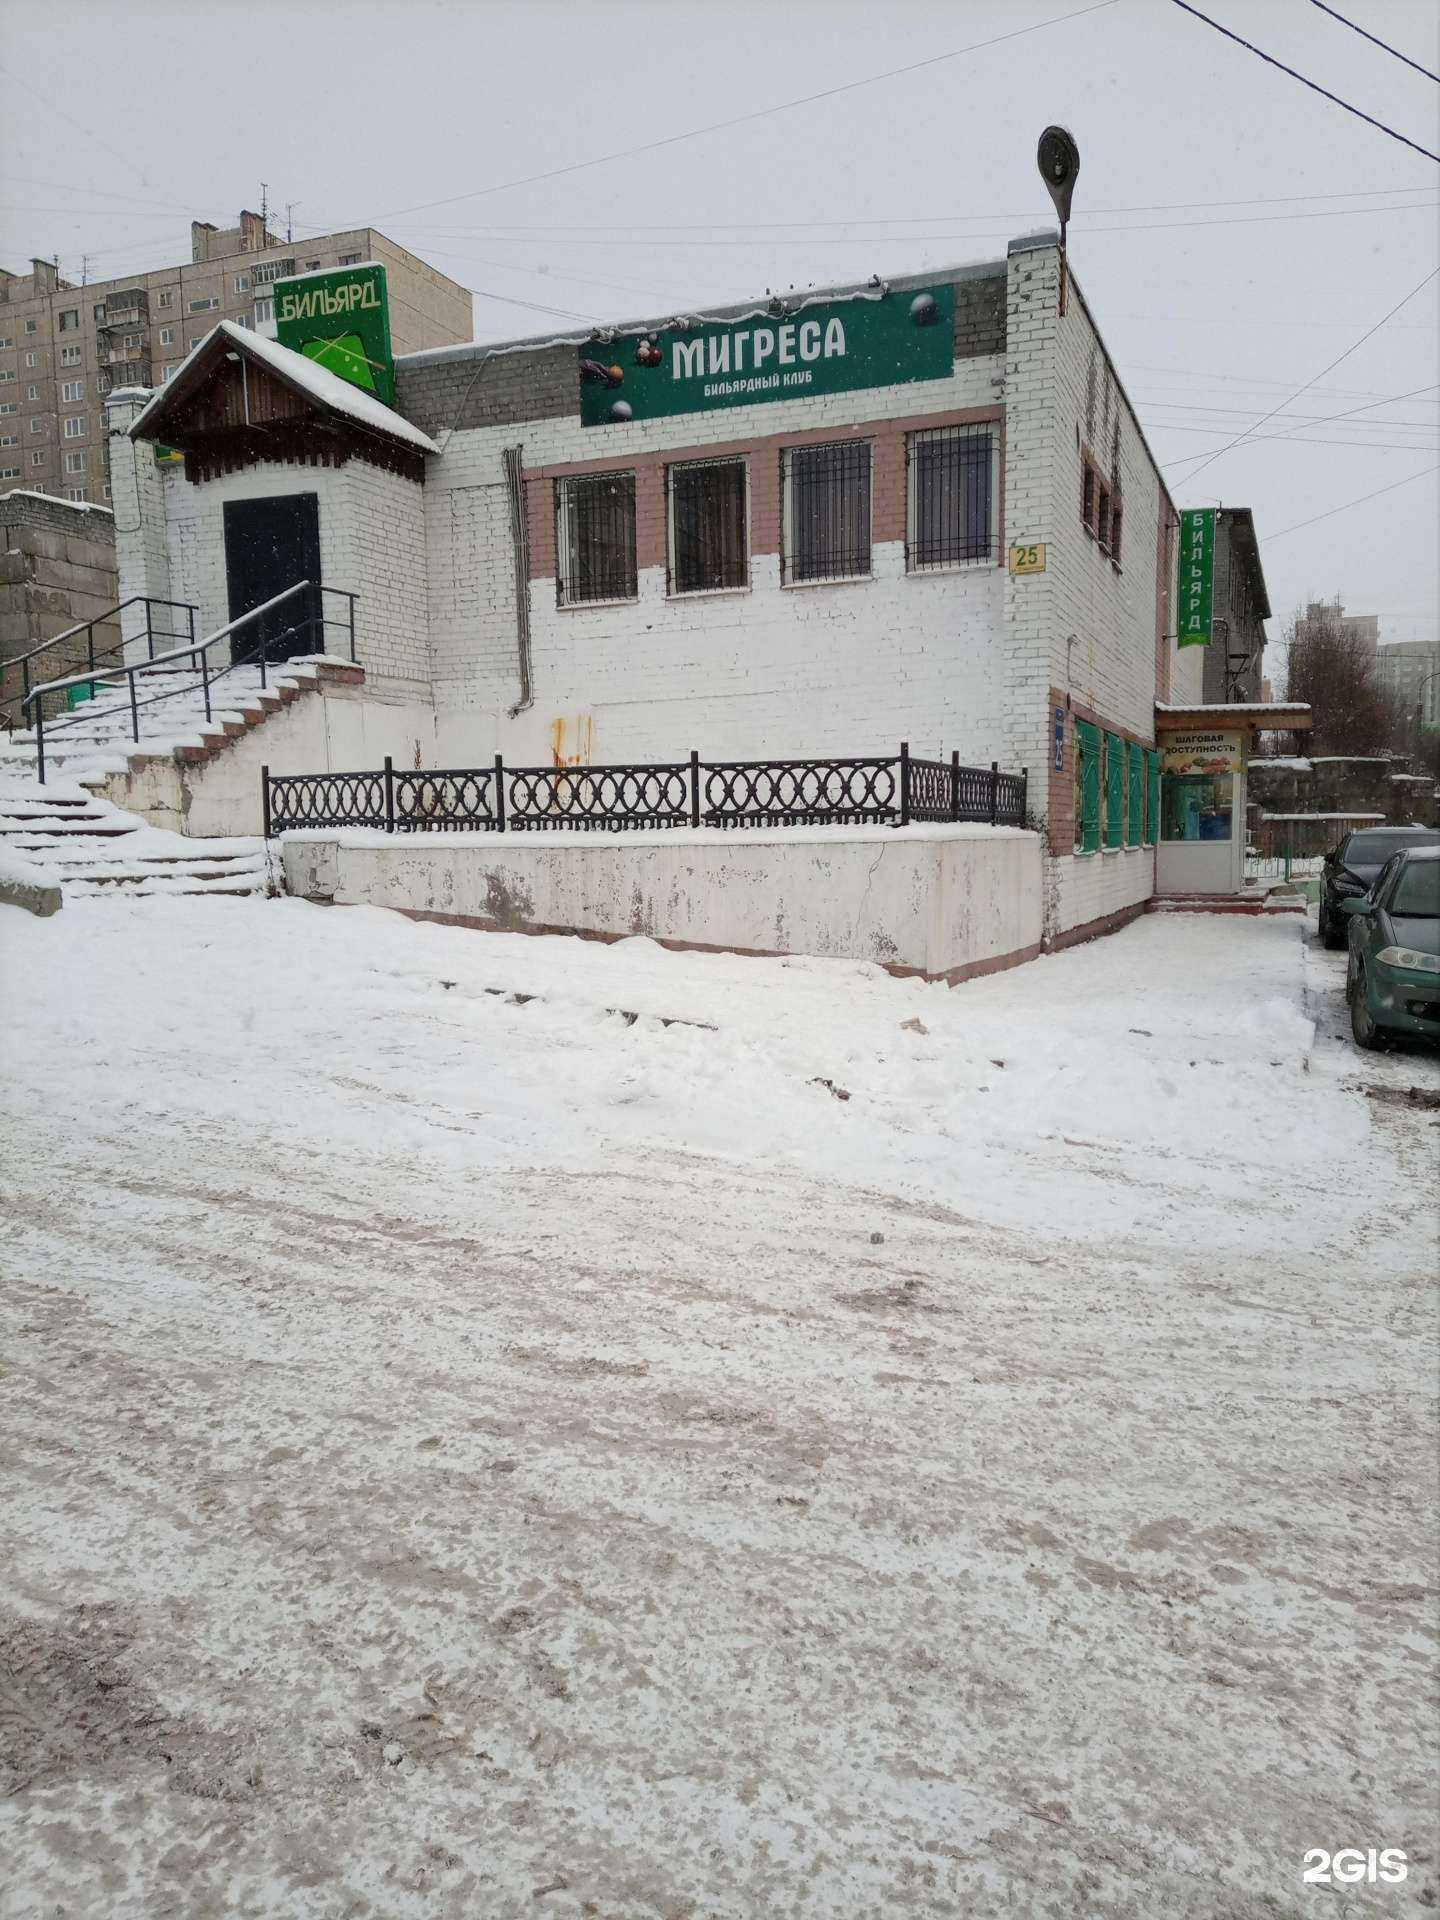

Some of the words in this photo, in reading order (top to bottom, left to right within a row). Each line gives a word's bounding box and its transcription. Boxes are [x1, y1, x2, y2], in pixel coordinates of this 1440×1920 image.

[278, 280, 381, 322] БИЛЬЯРД
[672, 317, 846, 379] МИГРЕСА
[704, 373, 780, 397] БИЛЬЯРДНЫЙ
[783, 370, 813, 385] КЛУБ
[1016, 545, 1038, 567] 25
[1188, 513, 1204, 630] БИЛЬЯРД
[1175, 734, 1224, 744] ШАГОВАЯ
